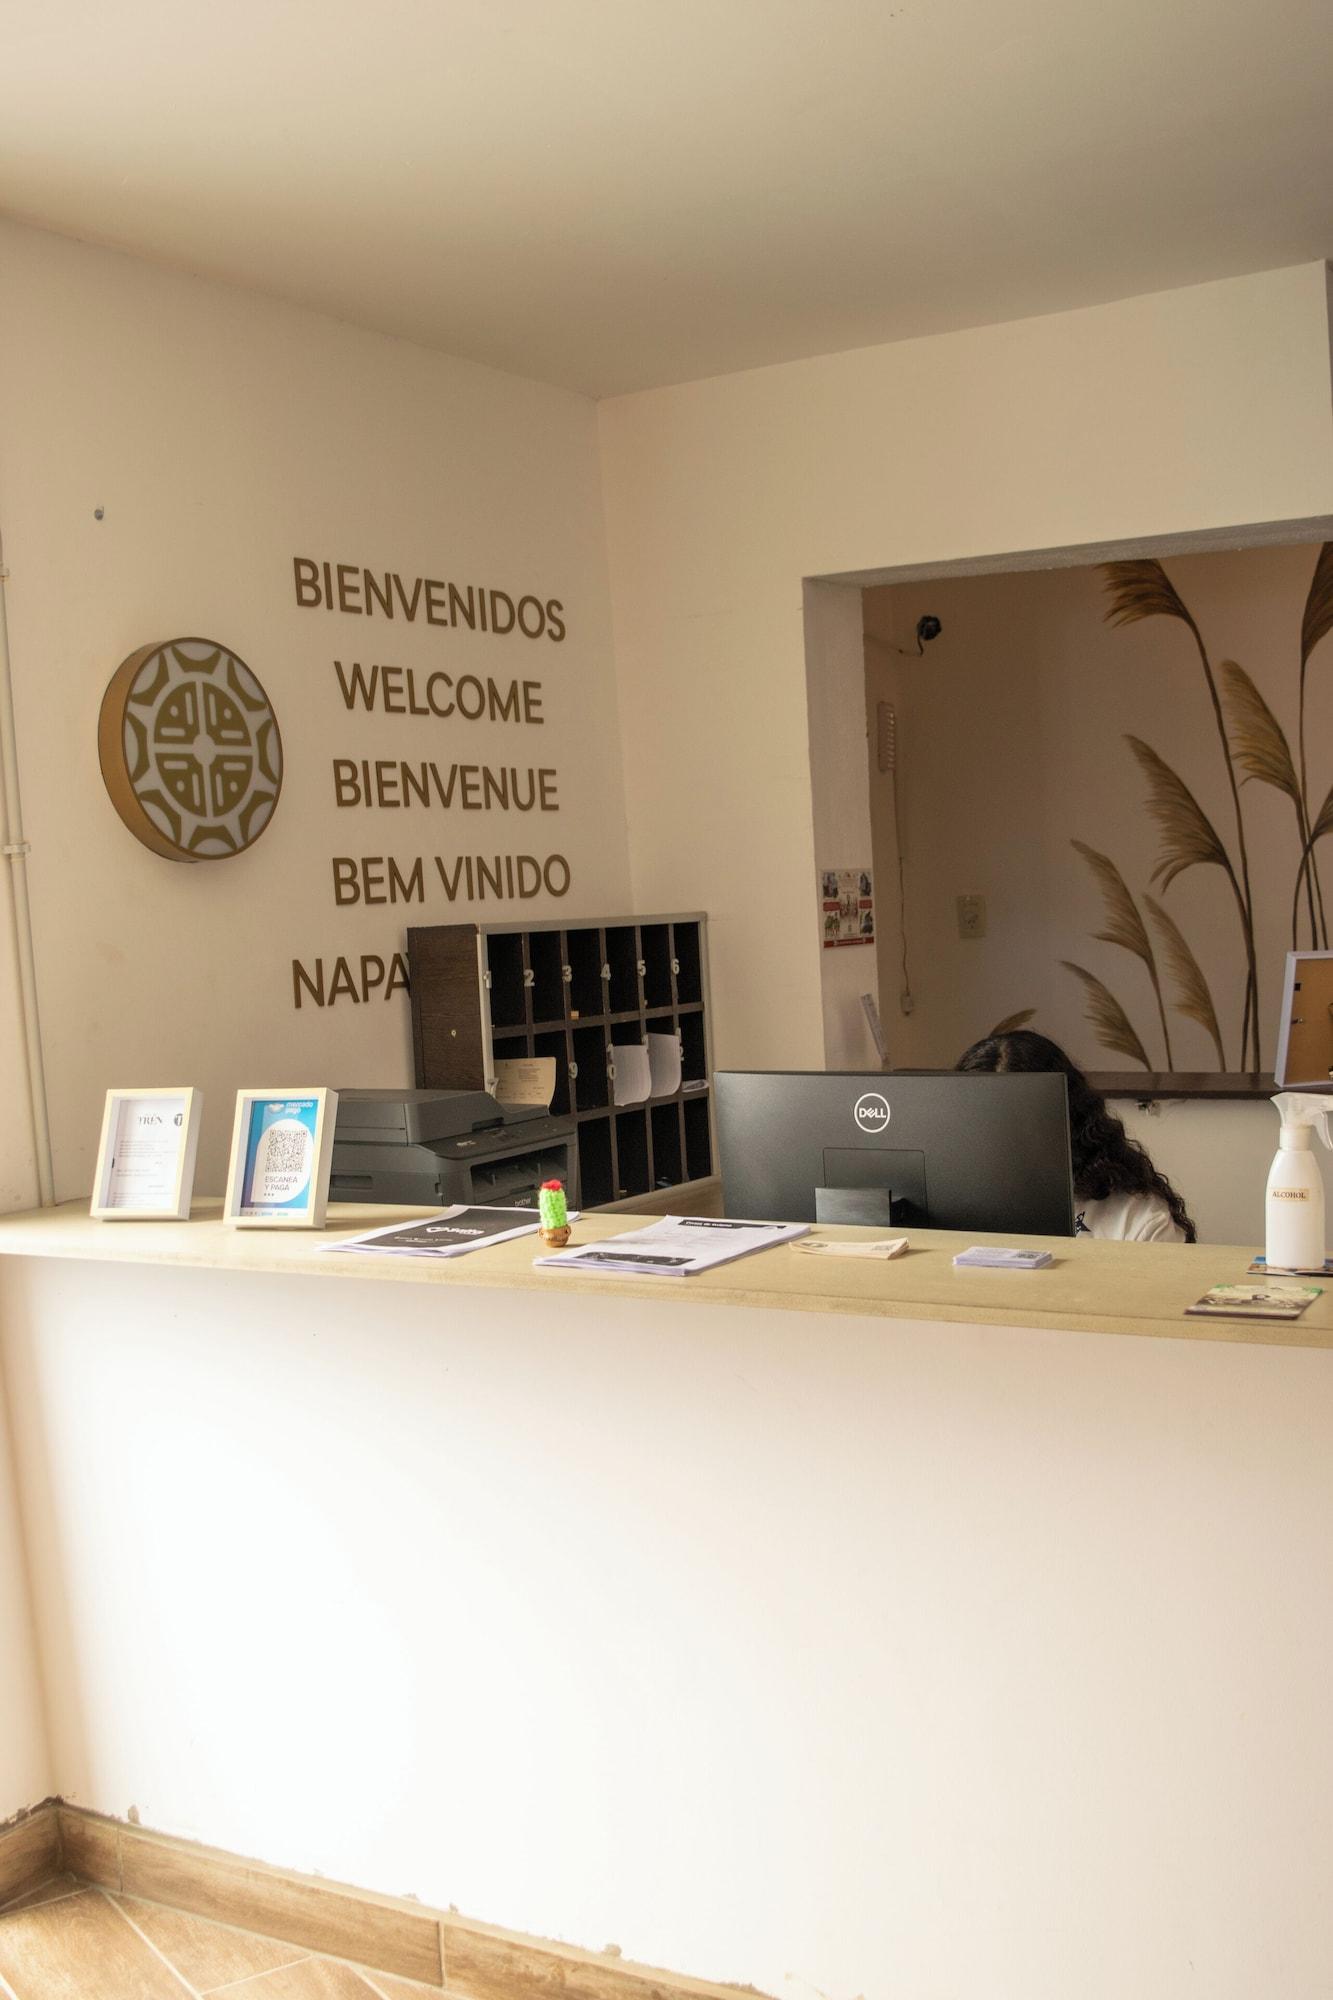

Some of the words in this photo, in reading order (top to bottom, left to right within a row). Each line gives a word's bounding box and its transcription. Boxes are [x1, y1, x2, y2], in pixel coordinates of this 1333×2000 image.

[294, 557, 566, 642] BIENVENIDOS
[334, 661, 545, 725] WELCOME
[333, 759, 560, 812] BIENVENUE
[332, 856, 425, 906] BEM
[435, 854, 570, 903] VINIDO
[292, 952, 411, 1009] NAPA
[523, 968, 535, 987] 2
[562, 965, 573, 983] 3
[600, 963, 611, 981] 4
[637, 959, 647, 977] 5
[670, 958, 680, 975] 6
[568, 1062, 578, 1079] 9
[859, 1107, 887, 1118] DELL
[1273, 1191, 1306, 1199] ALCOHOL
